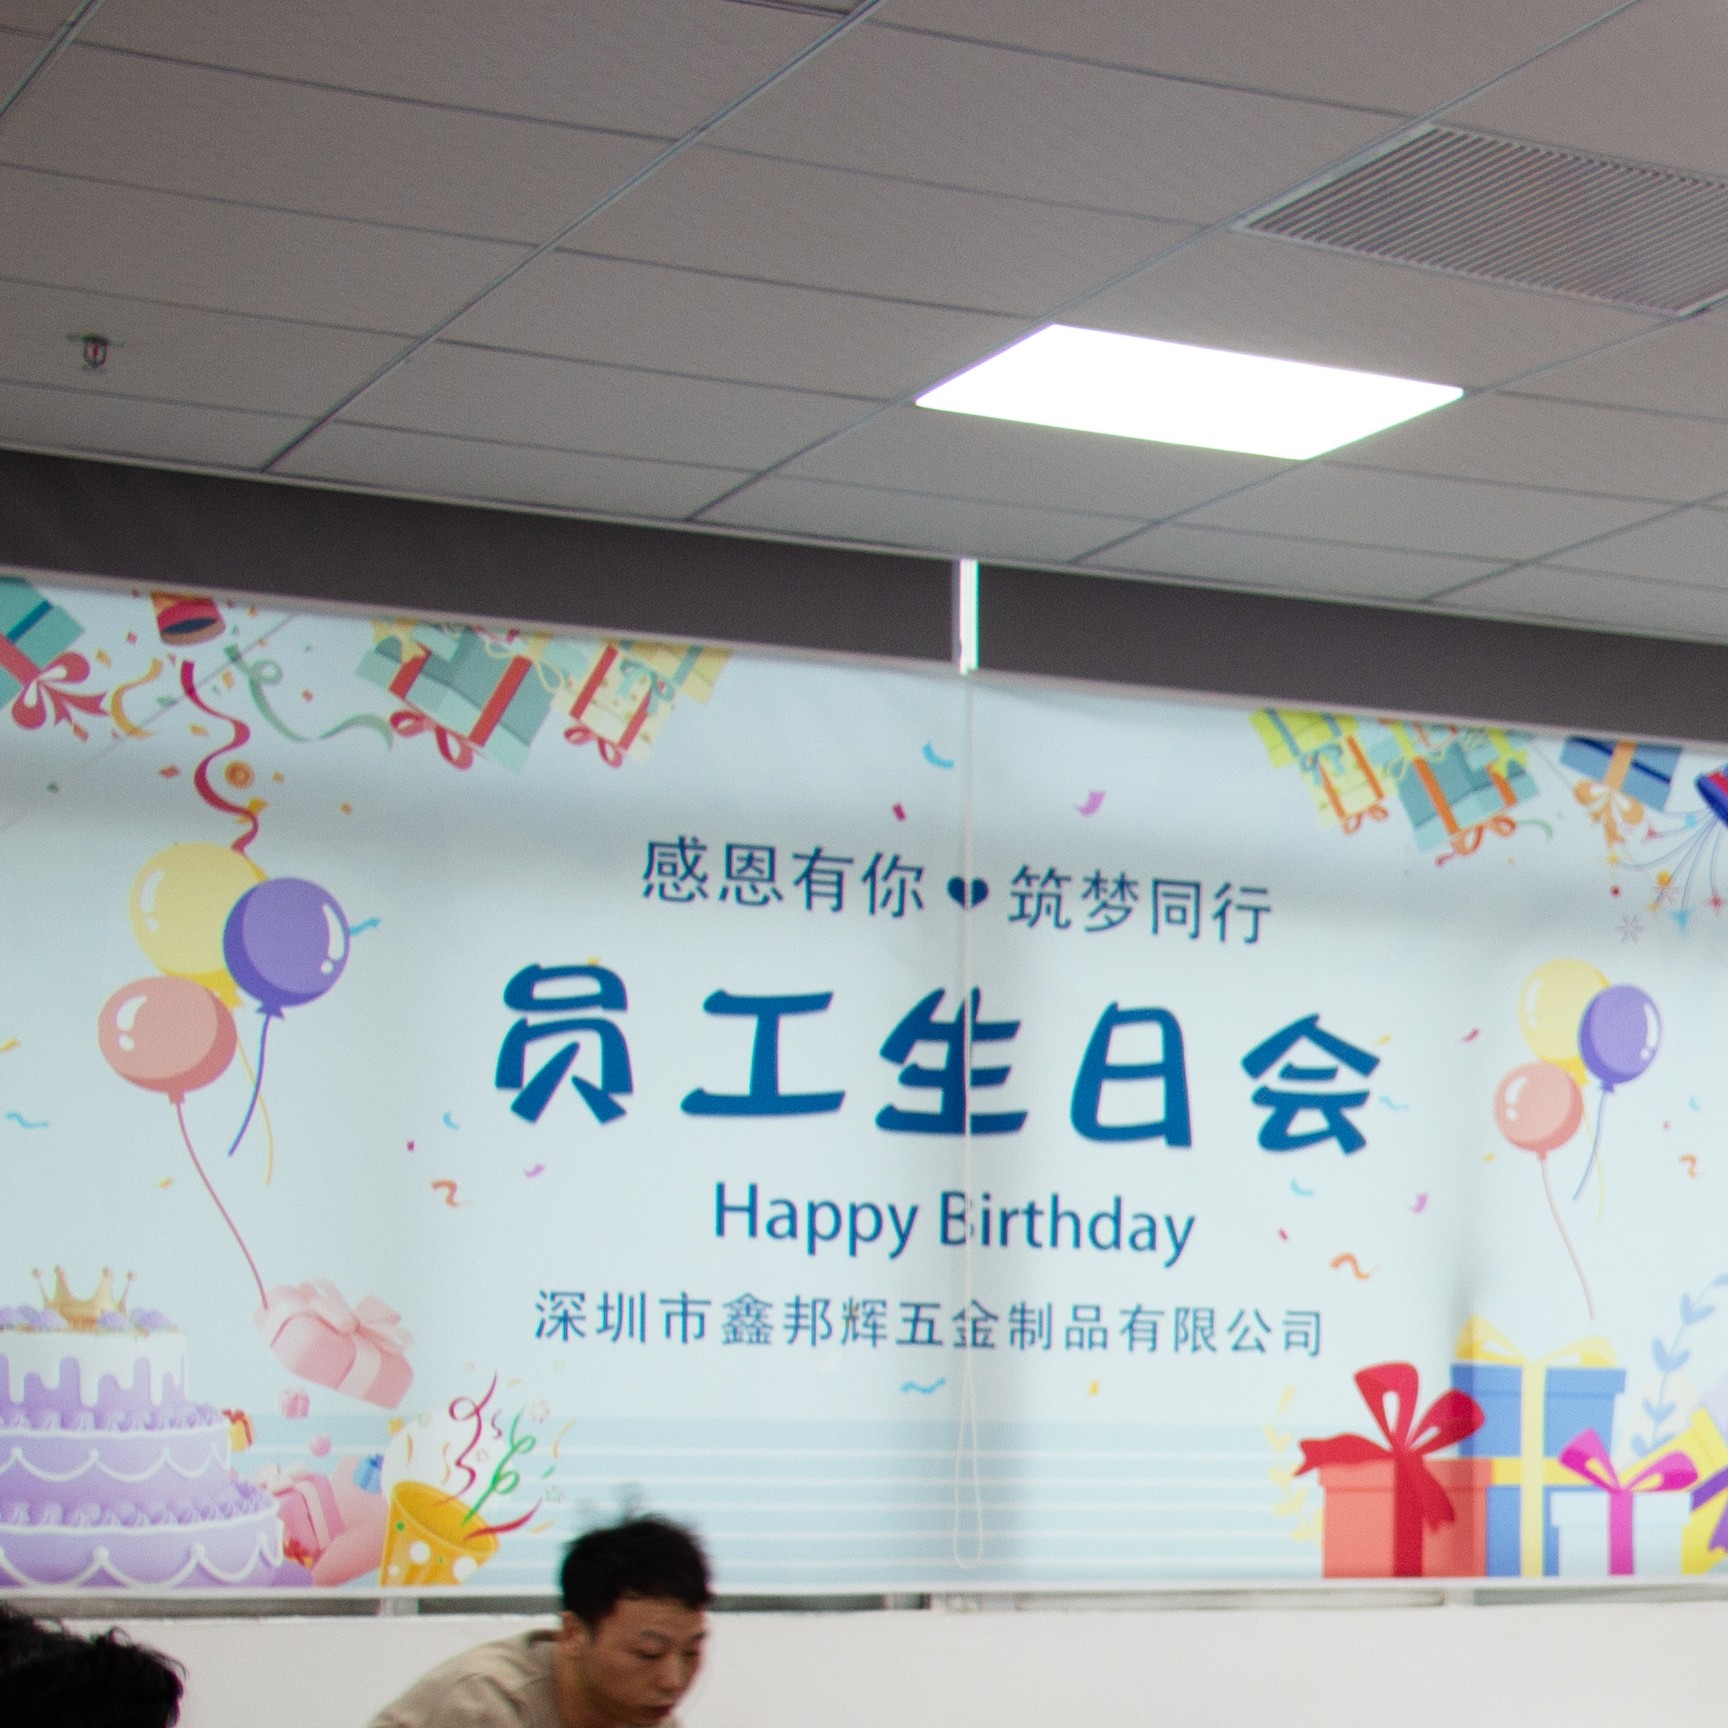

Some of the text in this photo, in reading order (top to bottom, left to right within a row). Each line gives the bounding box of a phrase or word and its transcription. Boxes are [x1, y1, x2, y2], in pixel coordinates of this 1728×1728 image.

[640, 836, 1274, 944] 感恩有你 筑梦同行
[493, 962, 1380, 1156] 员工生日会
[714, 1180, 1196, 1267] Happy Birthday
[534, 1288, 1323, 1357] 深圳市鑫邦辉五金制品有限公司
